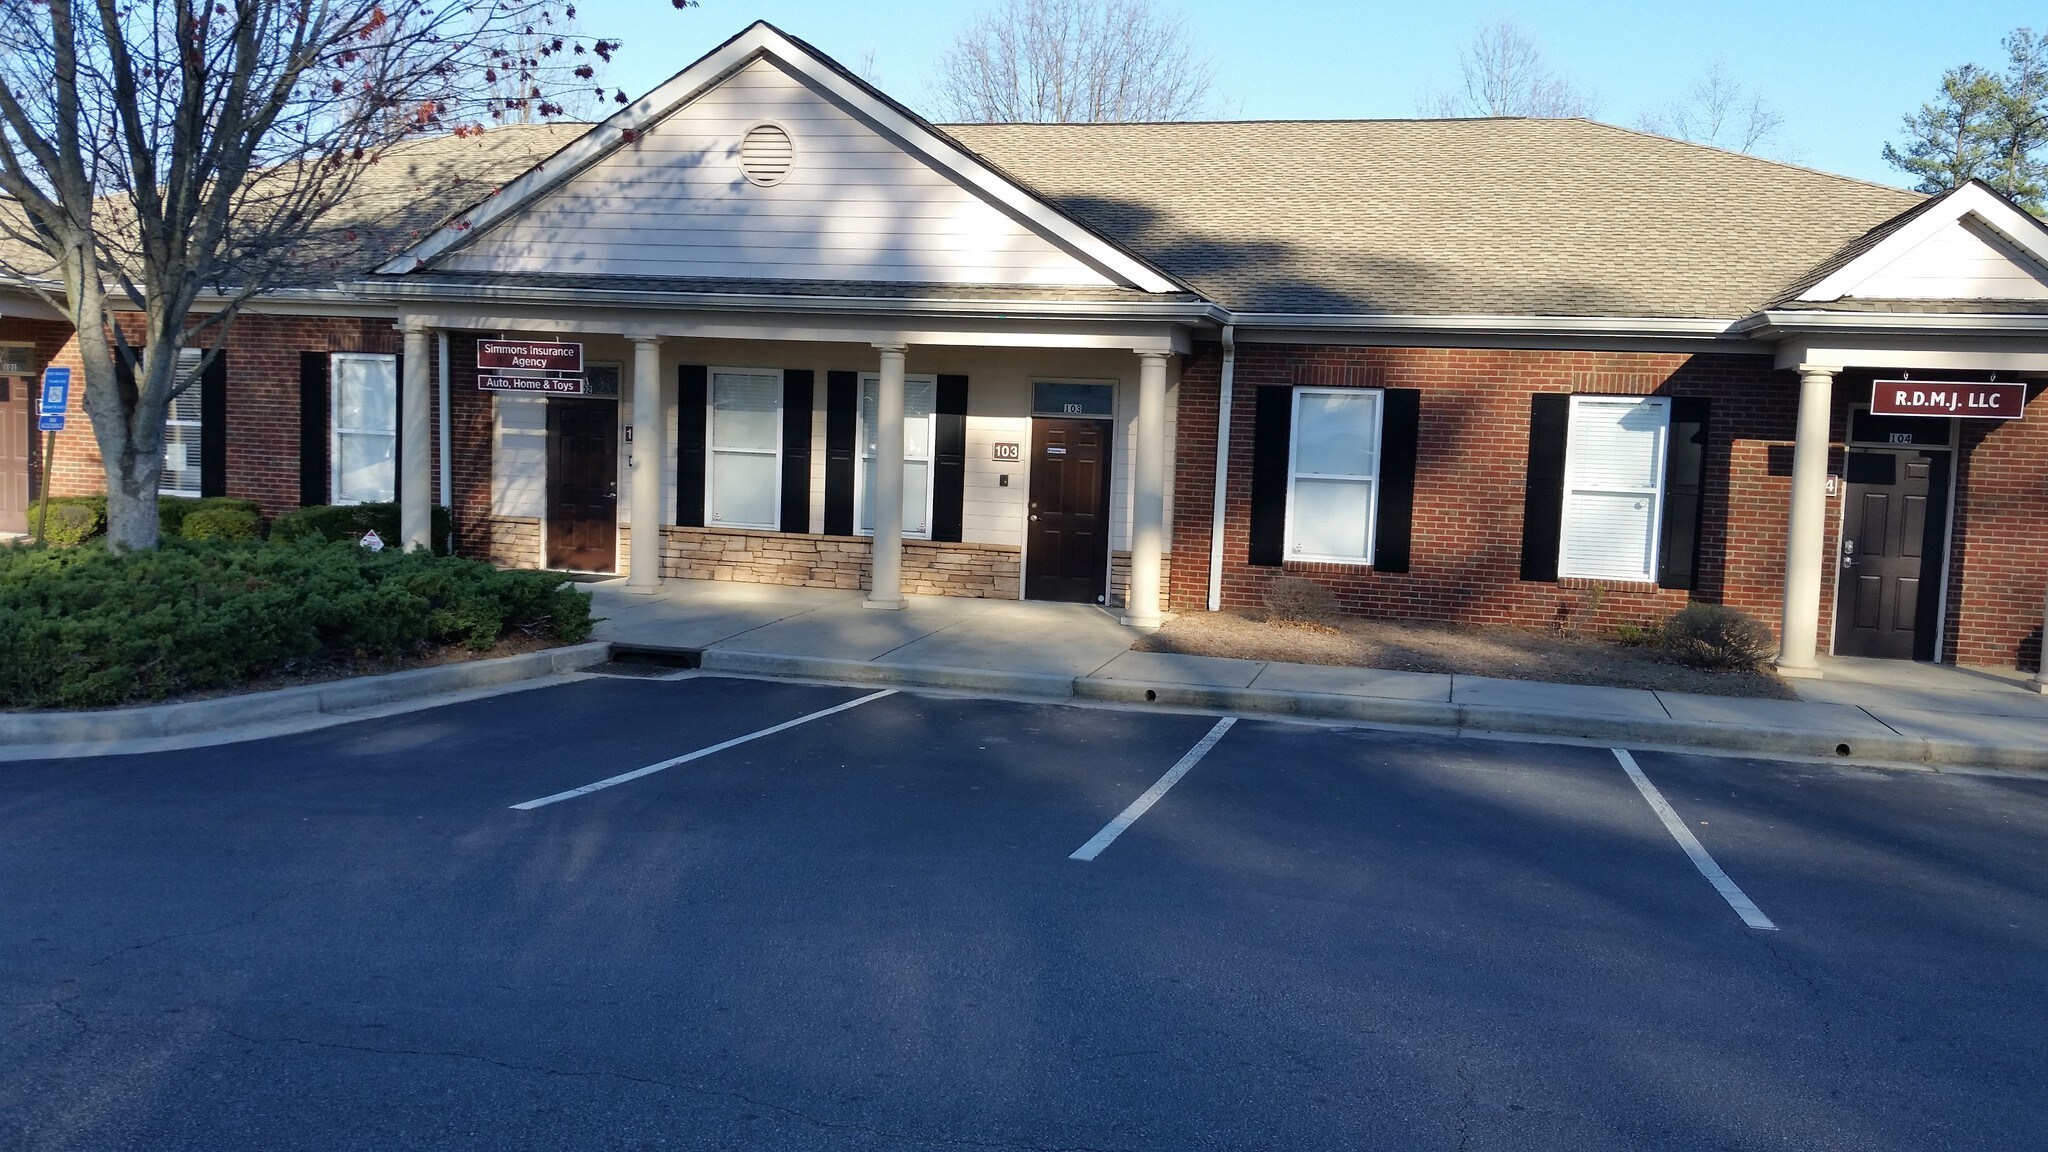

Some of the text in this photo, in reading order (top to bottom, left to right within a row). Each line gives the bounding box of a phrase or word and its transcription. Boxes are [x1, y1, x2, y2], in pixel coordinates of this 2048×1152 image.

[484, 343, 574, 357] Simmons Insurance
[512, 356, 547, 368] Agency
[486, 378, 574, 391] Auto, Home & Toys
[1895, 390, 2001, 412] R.D.M.J. LLC
[1065, 404, 1081, 413] 103
[1890, 434, 1912, 444] 104
[995, 445, 1018, 458] 103
